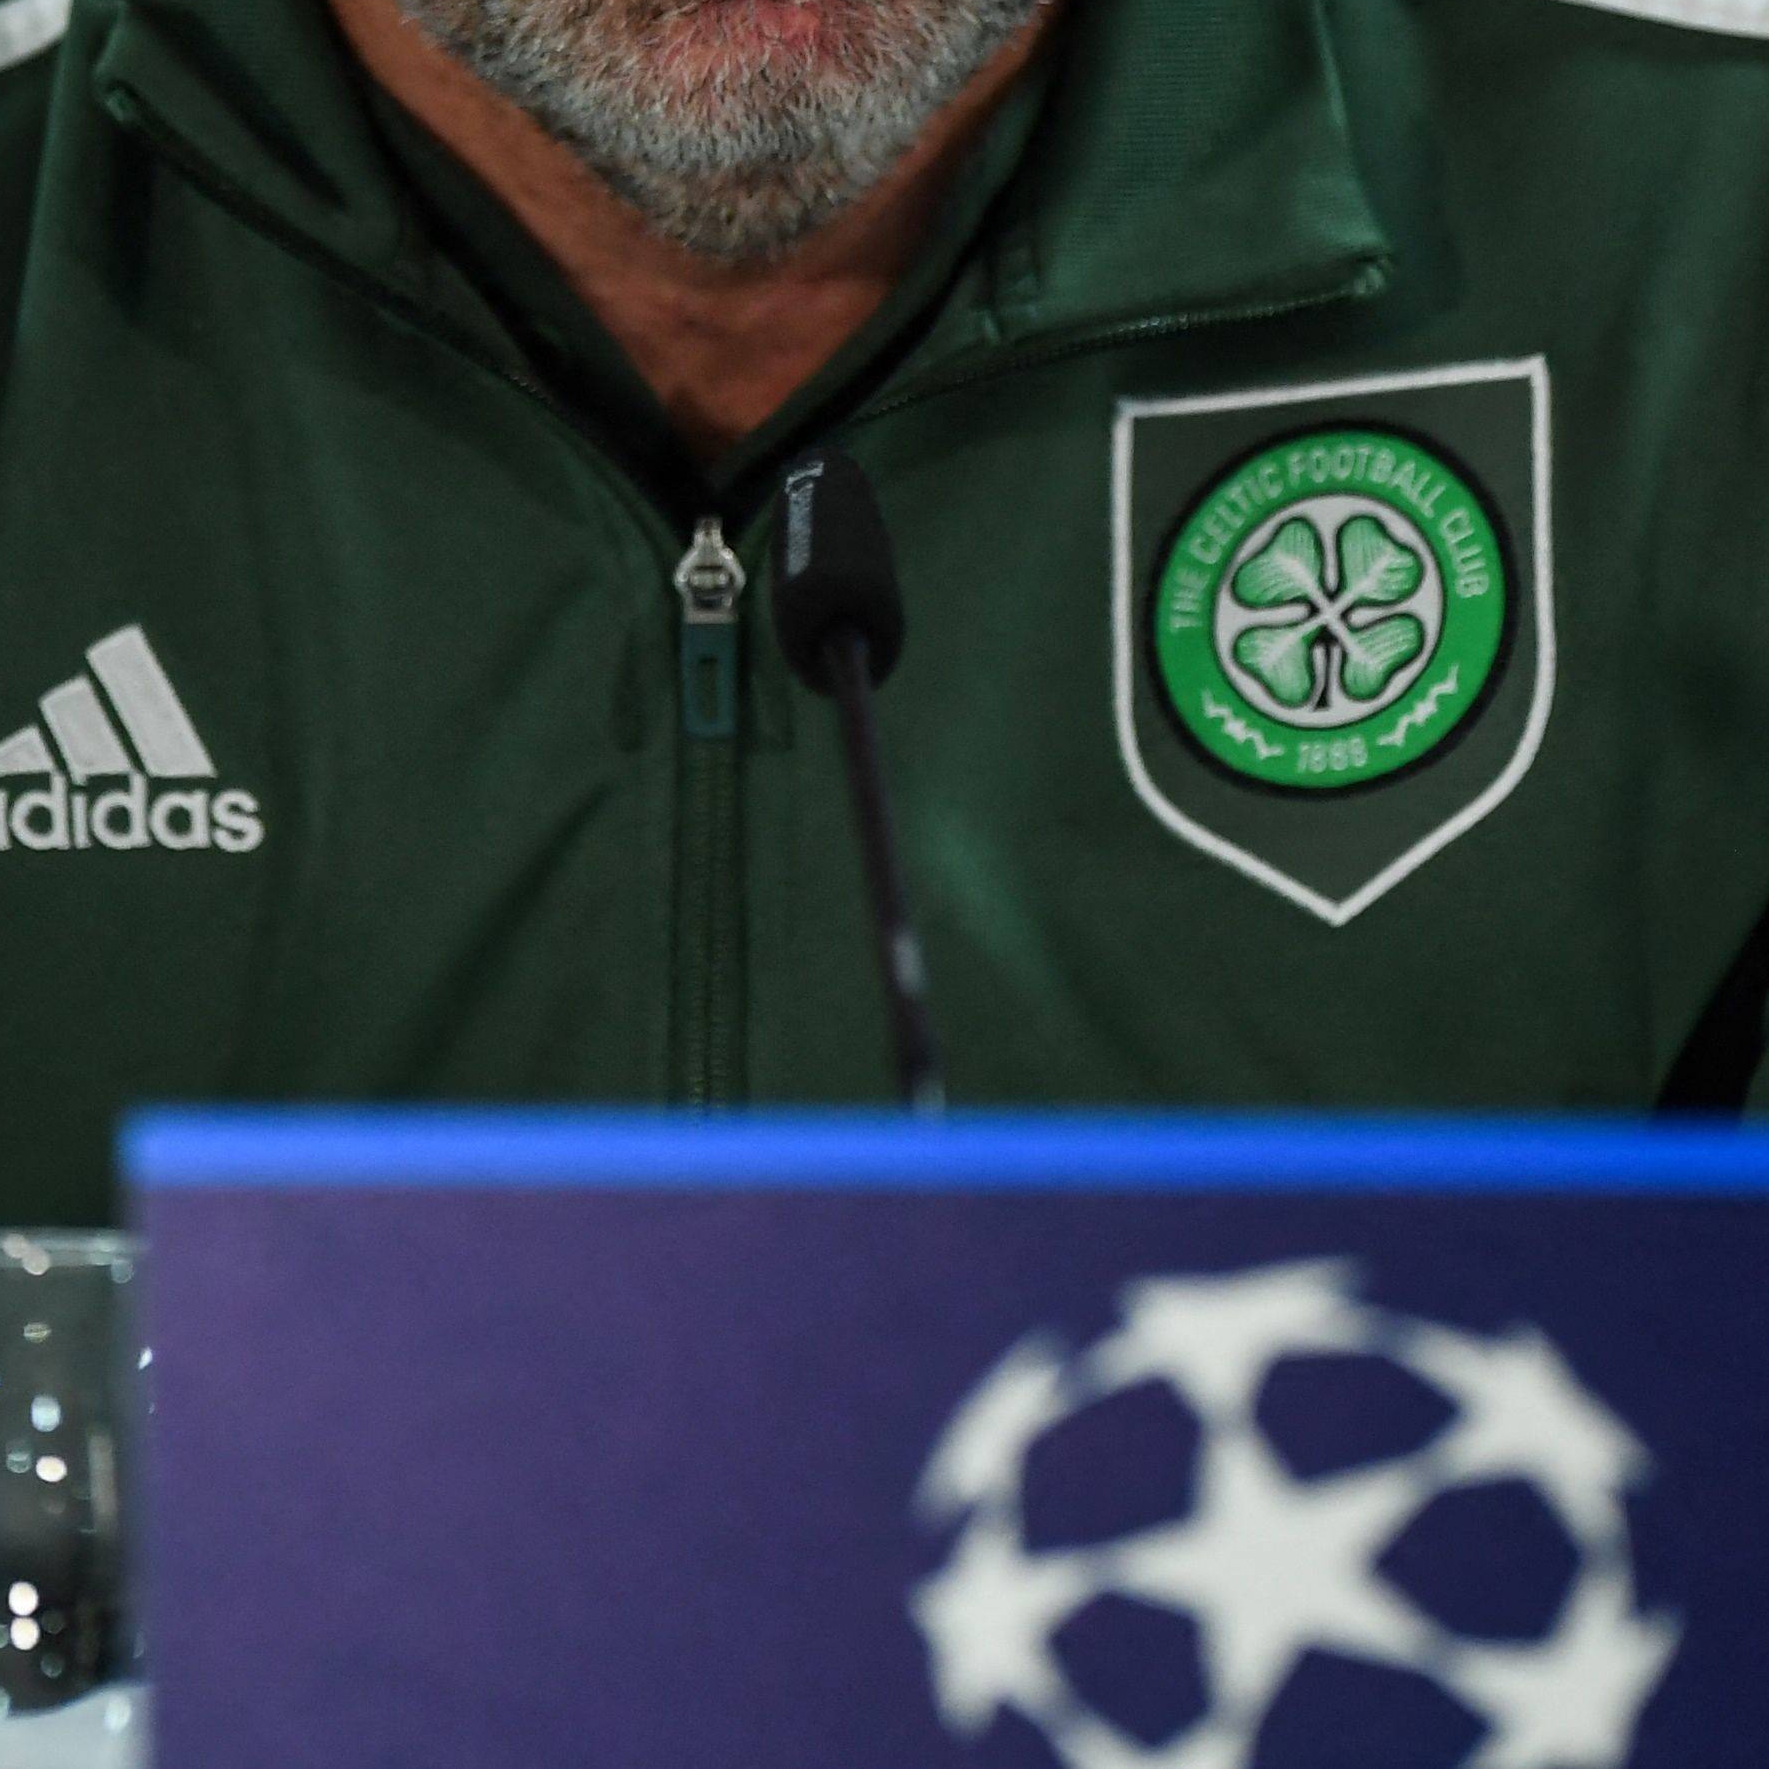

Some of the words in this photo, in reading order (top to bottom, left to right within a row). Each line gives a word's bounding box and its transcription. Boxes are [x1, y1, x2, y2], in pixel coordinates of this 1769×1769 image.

[1170, 569, 1210, 634] THE
[1190, 466, 1286, 564] CELTIC
[1287, 444, 1444, 518] FOOTBALL
[1439, 506, 1490, 600] CLUB
